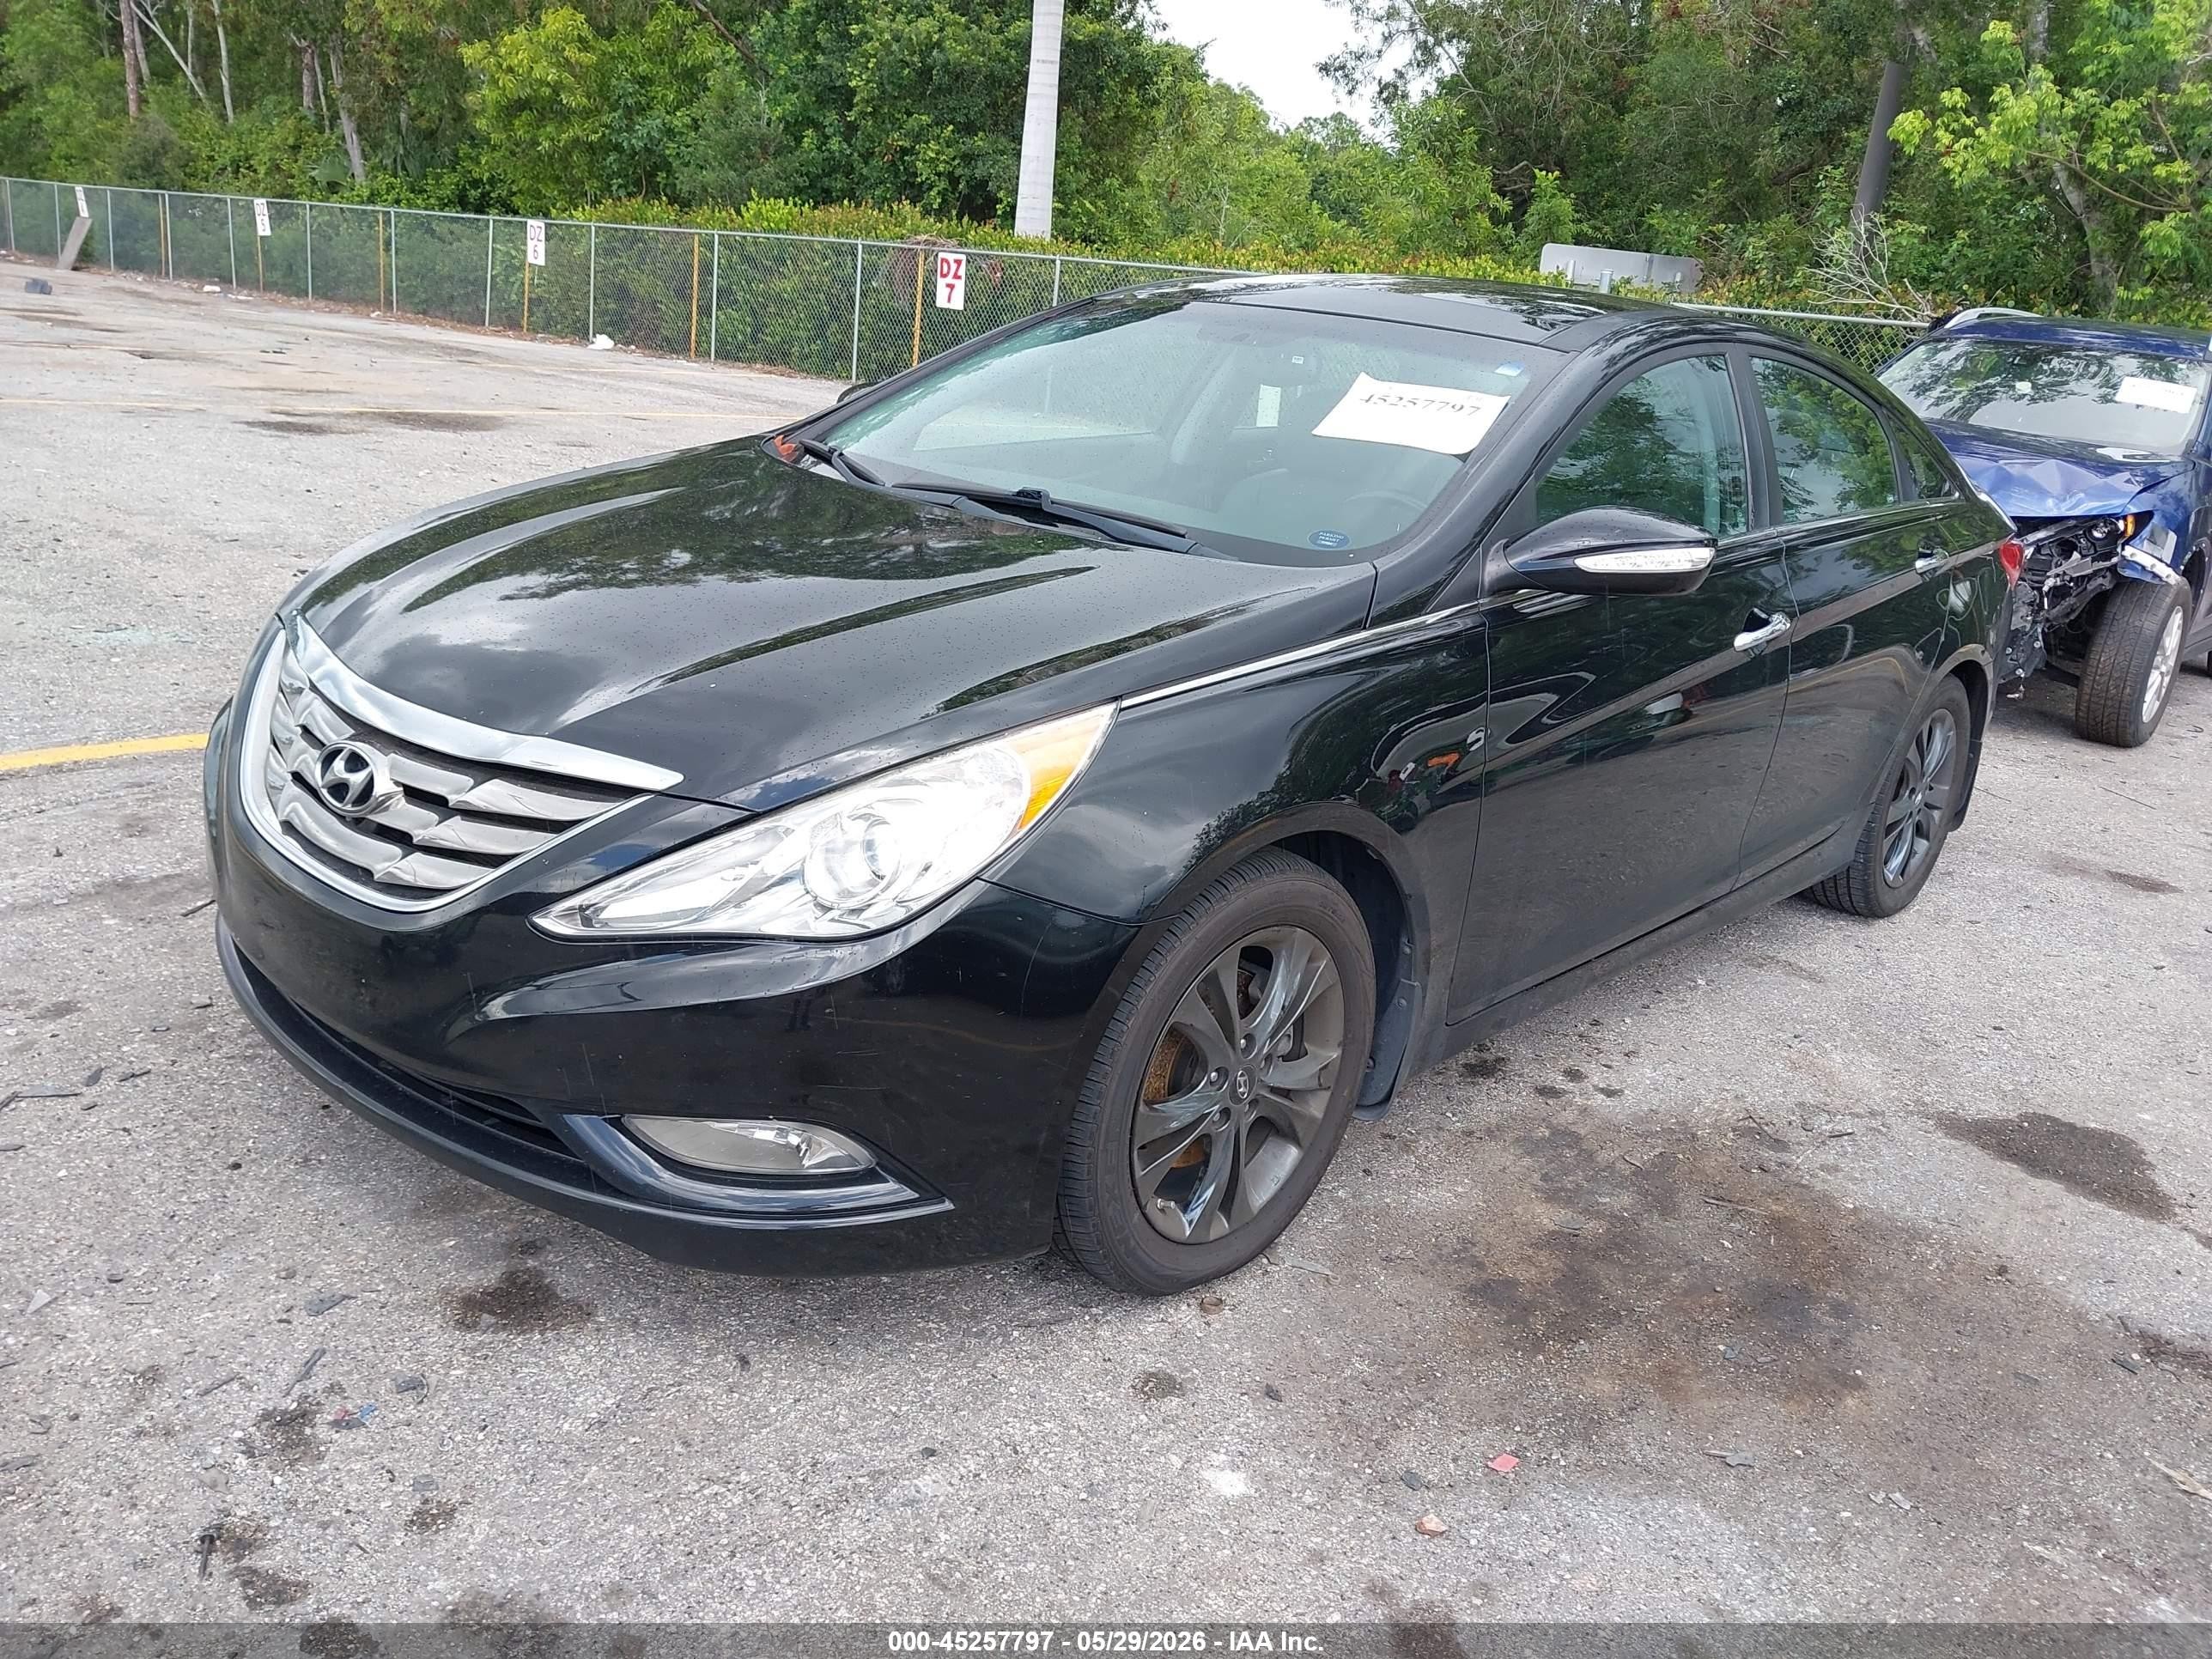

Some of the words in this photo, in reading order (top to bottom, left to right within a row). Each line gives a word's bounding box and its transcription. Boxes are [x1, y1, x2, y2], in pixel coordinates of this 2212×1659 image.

[530, 224, 543, 242] DZ
[532, 244, 539, 260] 6
[939, 257, 963, 281] DZ
[945, 283, 956, 304] 7
[1359, 393, 1482, 417] 45257797
